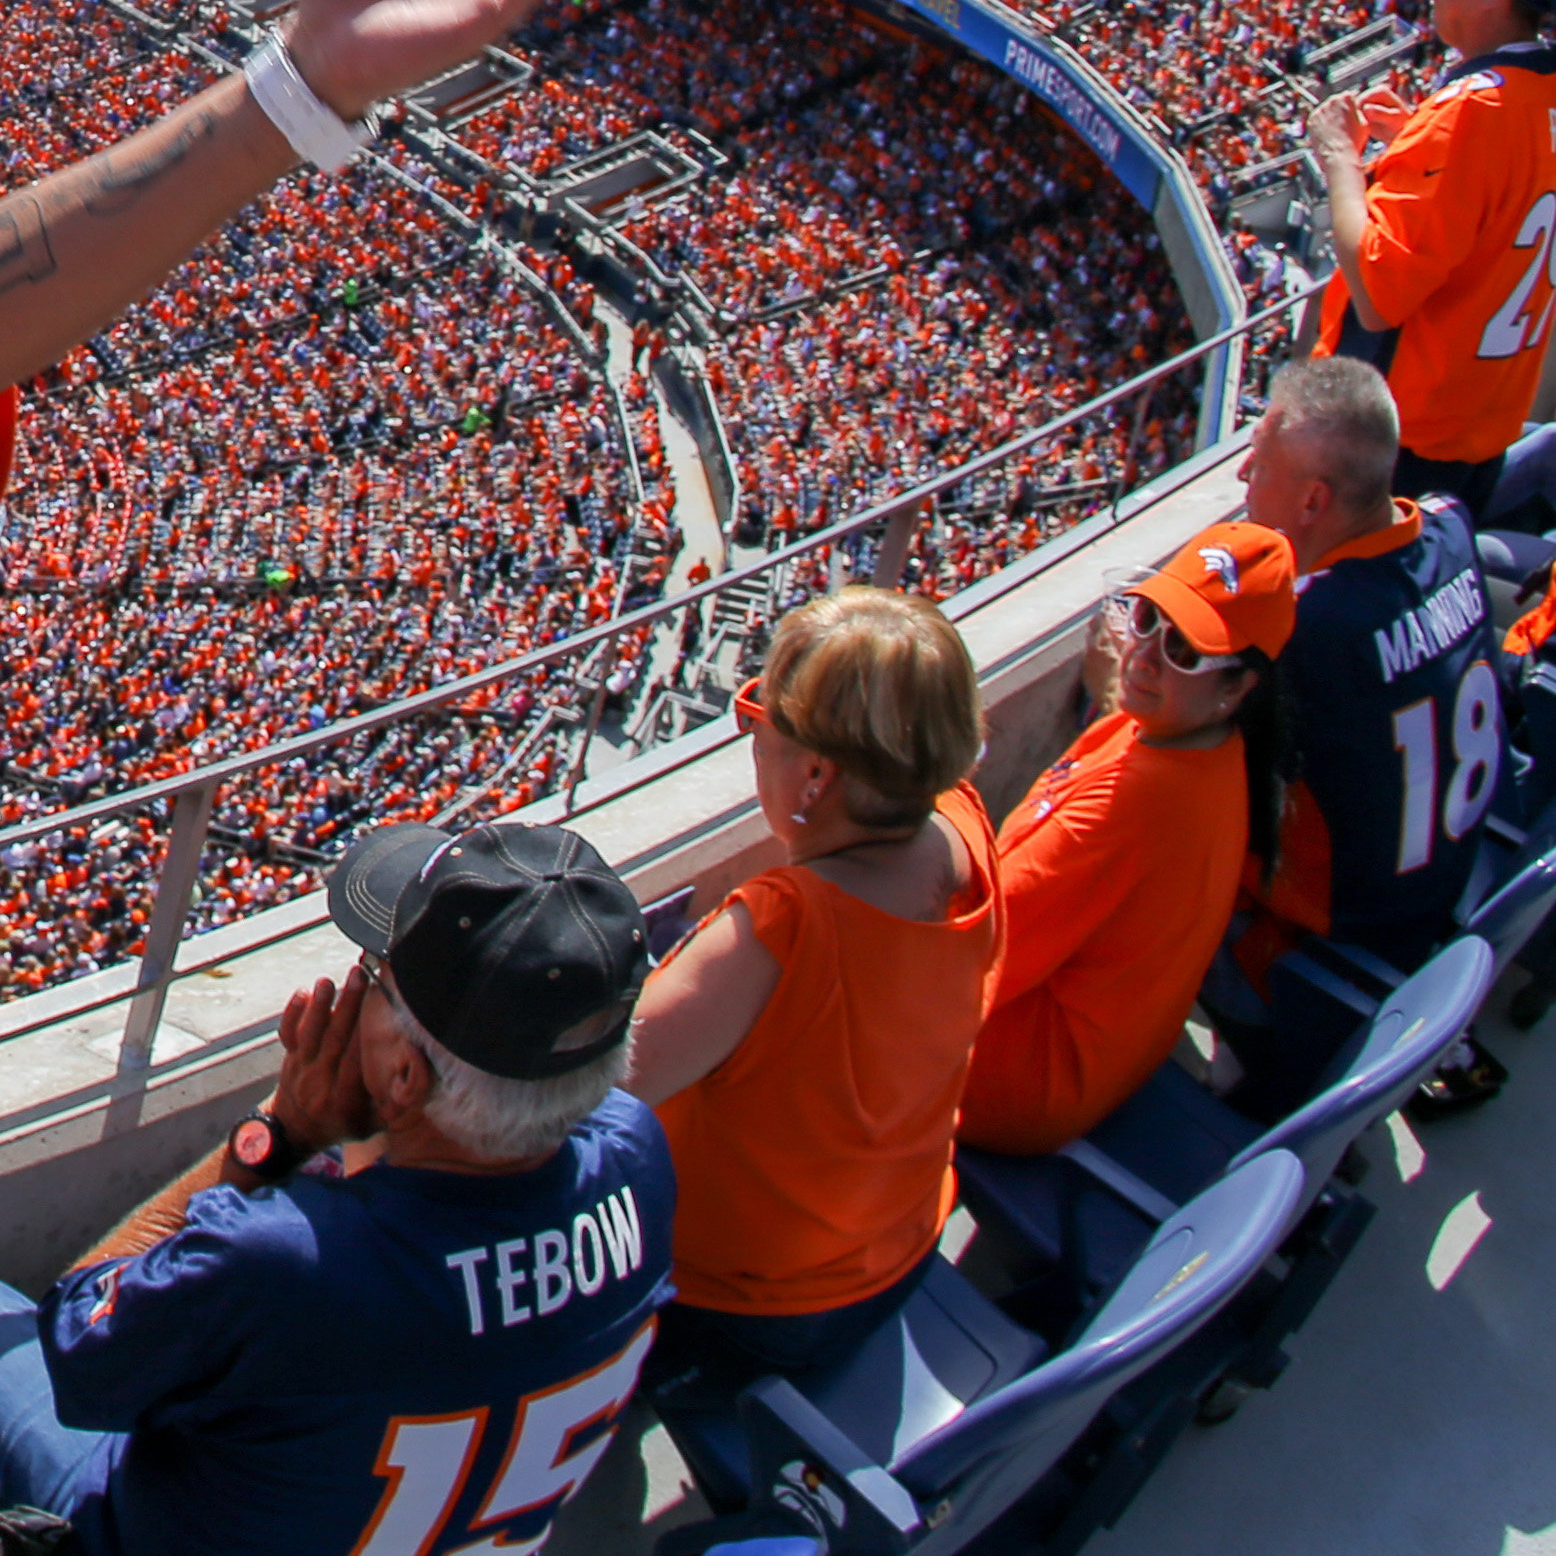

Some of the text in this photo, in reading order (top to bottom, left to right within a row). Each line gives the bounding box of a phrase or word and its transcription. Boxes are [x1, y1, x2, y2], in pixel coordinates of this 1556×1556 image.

[1003, 38, 1121, 164] PRIMESPORT.COM
[1374, 567, 1486, 684] MANNING
[1391, 658, 1502, 876] 18
[445, 1185, 643, 1336] TEBOW
[346, 1311, 658, 1556] 15
